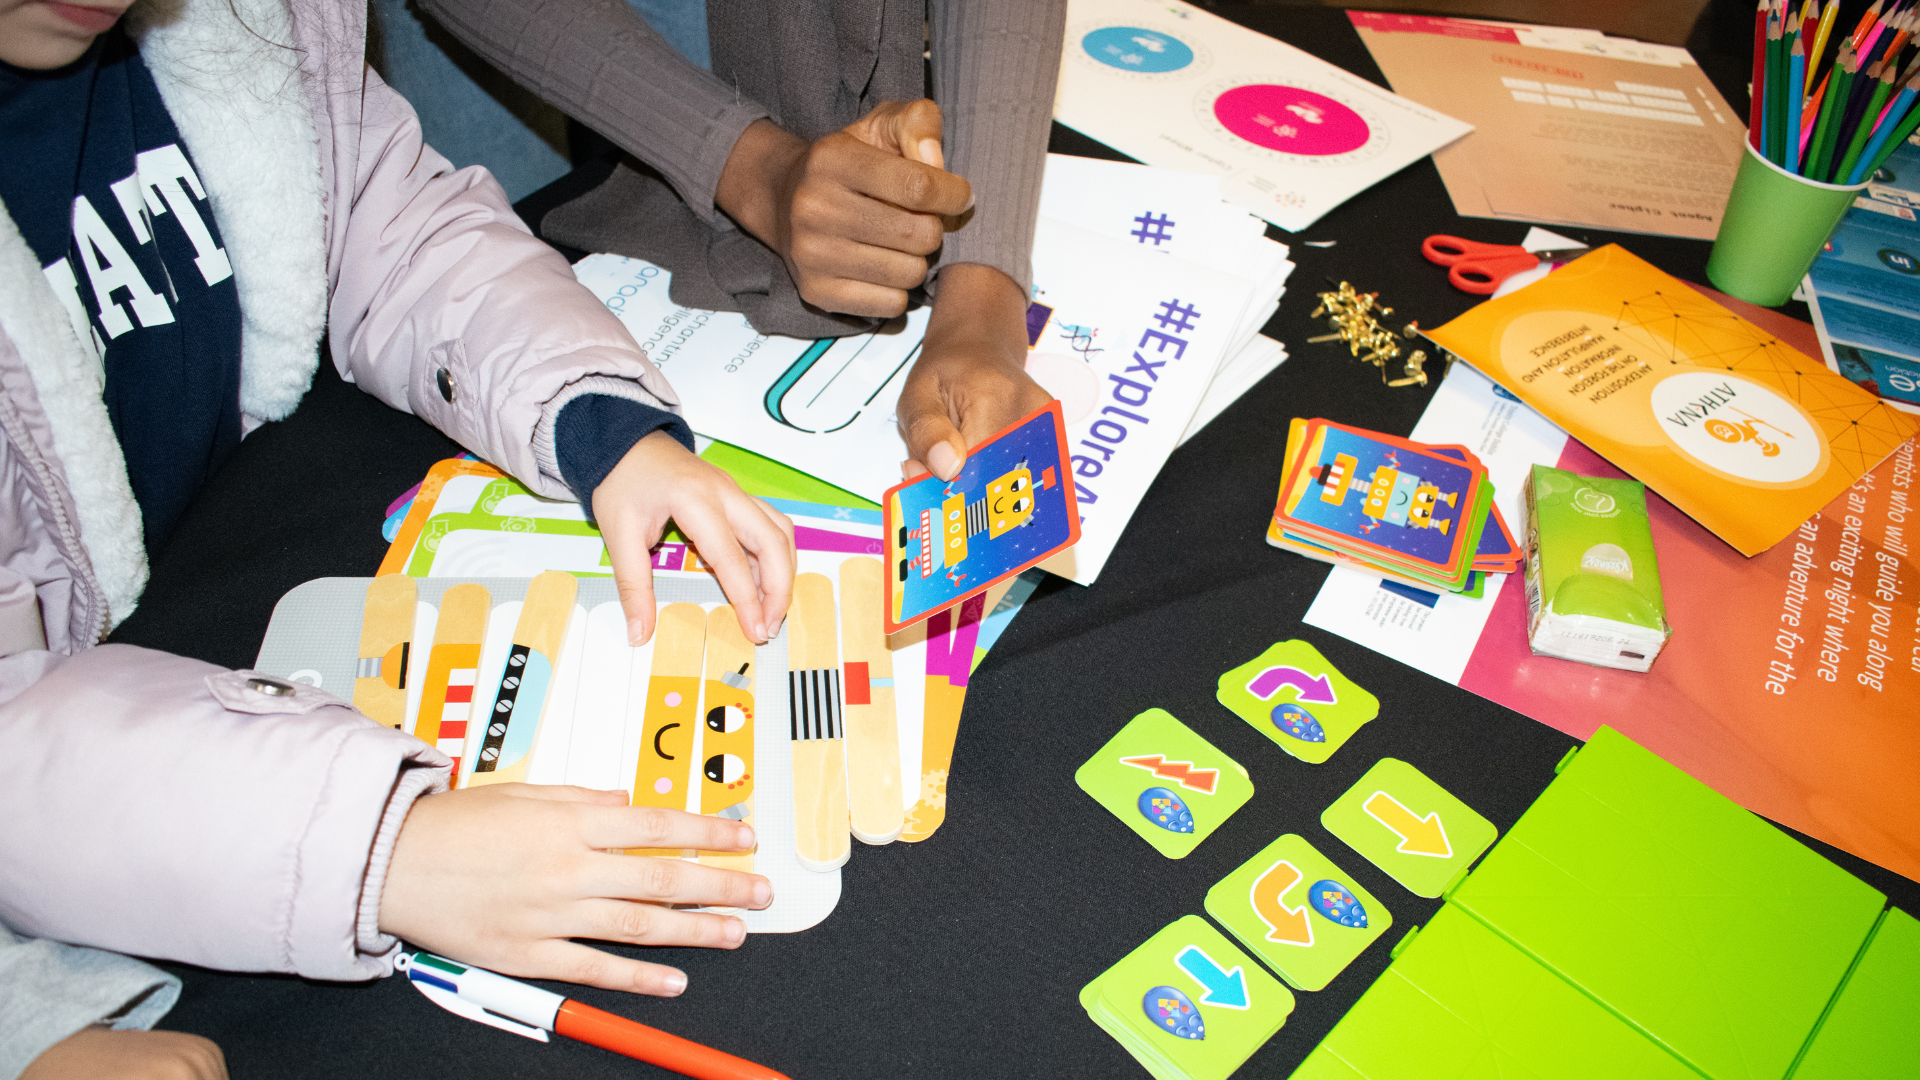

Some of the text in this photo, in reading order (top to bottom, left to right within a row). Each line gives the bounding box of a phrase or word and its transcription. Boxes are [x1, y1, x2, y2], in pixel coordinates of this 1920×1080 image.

[606, 266, 660, 317] arad
[1521, 334, 1607, 385] MANIPULATION AND
[1529, 324, 1592, 359] INTERFERENCE
[1563, 344, 1623, 379] INFORMATION
[1568, 368, 1609, 396] FOREIGN
[1588, 370, 1641, 405] EXPOSITION
[1847, 493, 1866, 513] an
[1888, 490, 1913, 523] who
[1830, 514, 1865, 577] exciting
[1883, 525, 1908, 557] will
[1584, 555, 1629, 574] Kleenex
[1875, 551, 1903, 602] guide
[1765, 520, 1819, 695] an adventure for the
[1824, 577, 1856, 624] night
[1868, 601, 1893, 639] you
[1817, 625, 1850, 683] where
[1857, 638, 1894, 692] along
